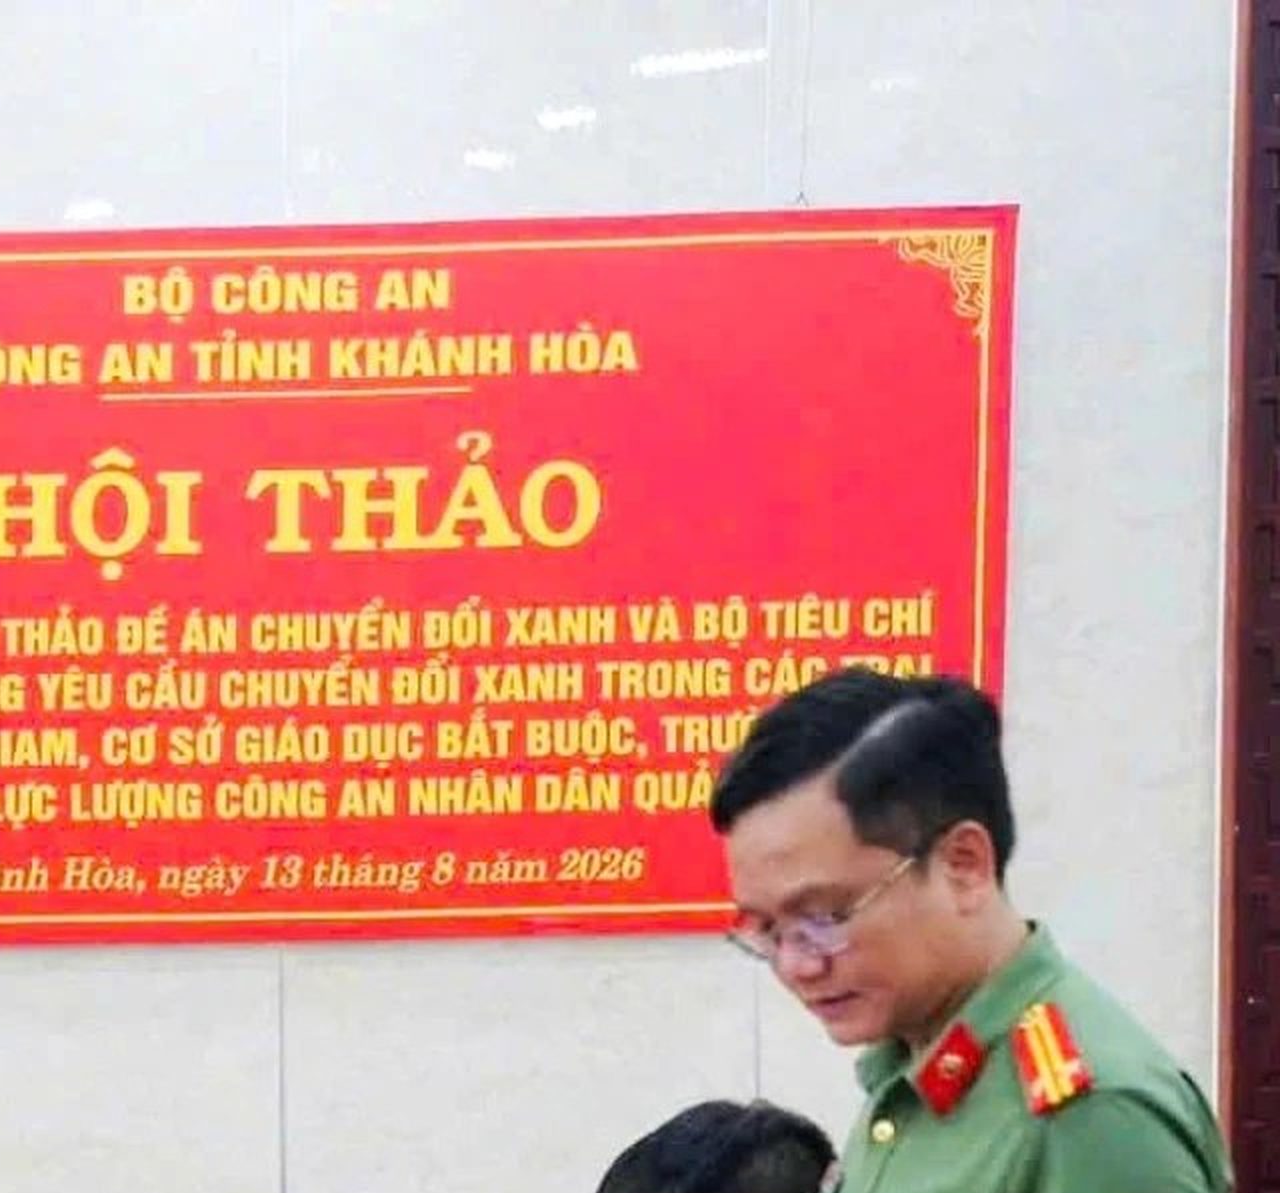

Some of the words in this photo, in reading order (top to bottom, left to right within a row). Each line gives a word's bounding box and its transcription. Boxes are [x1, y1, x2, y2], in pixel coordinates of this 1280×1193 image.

[123, 265, 193, 324] BỘ
[212, 264, 358, 313] CÔNG
[375, 268, 451, 310] AN
[99, 343, 173, 384] AN
[189, 328, 311, 382] TỈNH
[329, 328, 512, 379] KHÁNH
[529, 321, 639, 374] HÒA
[245, 430, 603, 554] THẢO
[2, 602, 103, 656] THẢO
[180, 607, 237, 653] ÁN
[251, 596, 411, 652] CHUYỂN
[423, 594, 491, 648] ĐỔI
[506, 605, 617, 646] XANH
[628, 595, 680, 644] VÀ
[693, 595, 748, 648] BỘ
[761, 592, 850, 639] TIÊU
[863, 588, 936, 638] CHÍ
[39, 664, 112, 712] YÊU
[220, 653, 379, 710] CHUYỂN
[392, 651, 460, 704] ĐỔI
[474, 662, 583, 703] XANH
[596, 658, 731, 700] TRONG
[744, 649, 828, 696] CÁC
[102, 723, 158, 765] CƠ
[169, 713, 223, 765] SỞ
[235, 715, 330, 764] GIÁO
[343, 722, 424, 768] DỤC
[438, 706, 513, 760] BẮT
[527, 710, 648, 764] BUỘC,
[71, 778, 203, 828] LƯỢNG
[215, 774, 327, 821] CÔNG
[338, 778, 394, 818] AN
[409, 769, 522, 816] NHÂN
[536, 767, 620, 813] DÂN
[62, 855, 147, 893] Hòa,
[158, 855, 250, 897] ngày
[261, 853, 305, 889] 13
[313, 852, 425, 892] tháng
[432, 851, 455, 886] 8
[466, 852, 548, 885] năm
[557, 847, 645, 881] 2026
